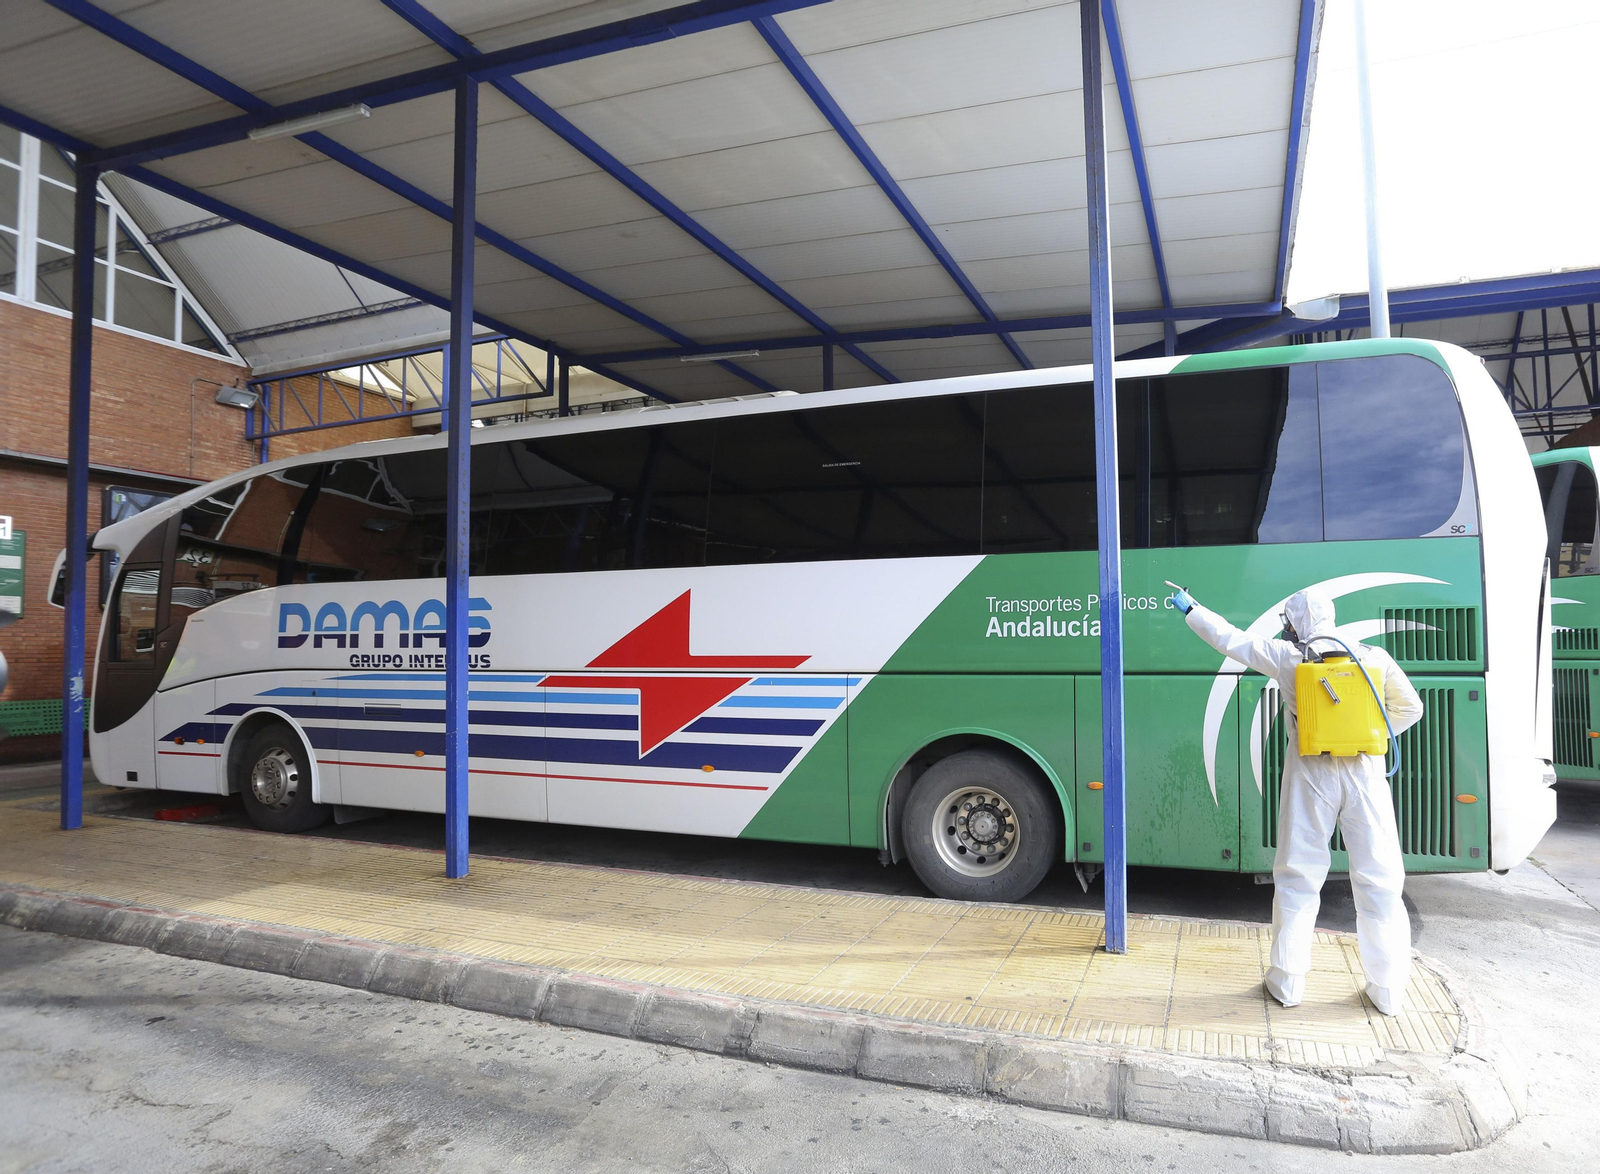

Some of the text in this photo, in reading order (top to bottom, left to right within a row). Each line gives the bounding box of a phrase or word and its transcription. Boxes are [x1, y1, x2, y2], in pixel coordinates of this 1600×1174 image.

[1450, 524, 1474, 534] SC7
[985, 595, 1082, 615] Transportes
[1087, 593, 1158, 611] Picos
[985, 613, 1102, 637] Andalucía
[349, 654, 491, 669] GRUPO INTEUS
